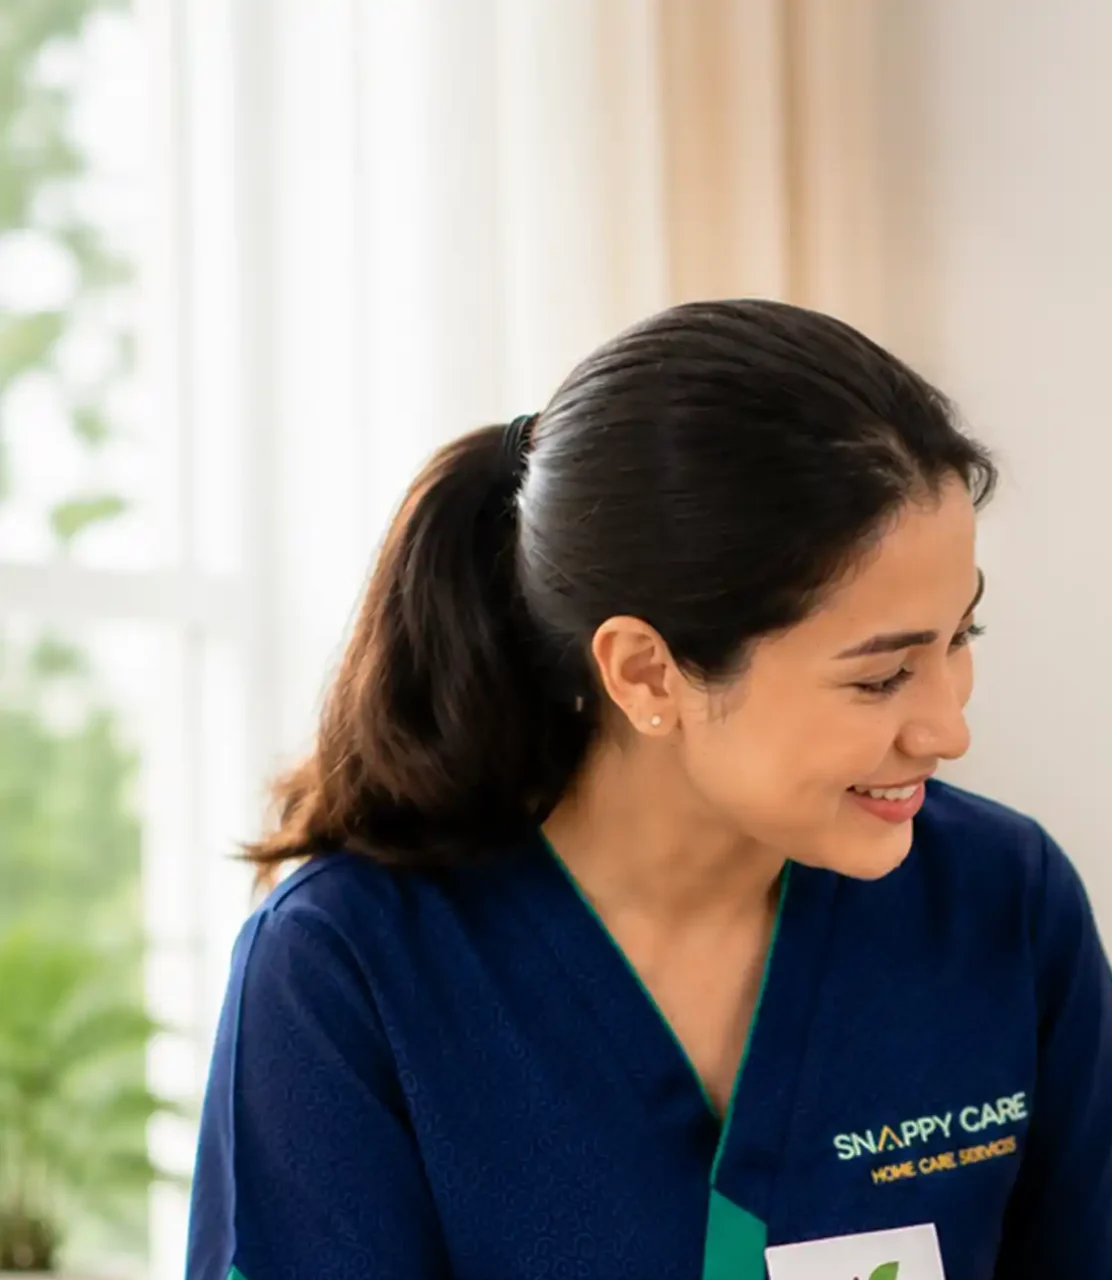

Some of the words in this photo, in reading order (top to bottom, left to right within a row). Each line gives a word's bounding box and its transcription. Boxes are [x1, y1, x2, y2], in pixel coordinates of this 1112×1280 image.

[833, 1112, 952, 1159] SNAPPY
[959, 1091, 1027, 1132] CARE
[871, 1160, 916, 1184] HOME
[918, 1151, 957, 1174] CARE
